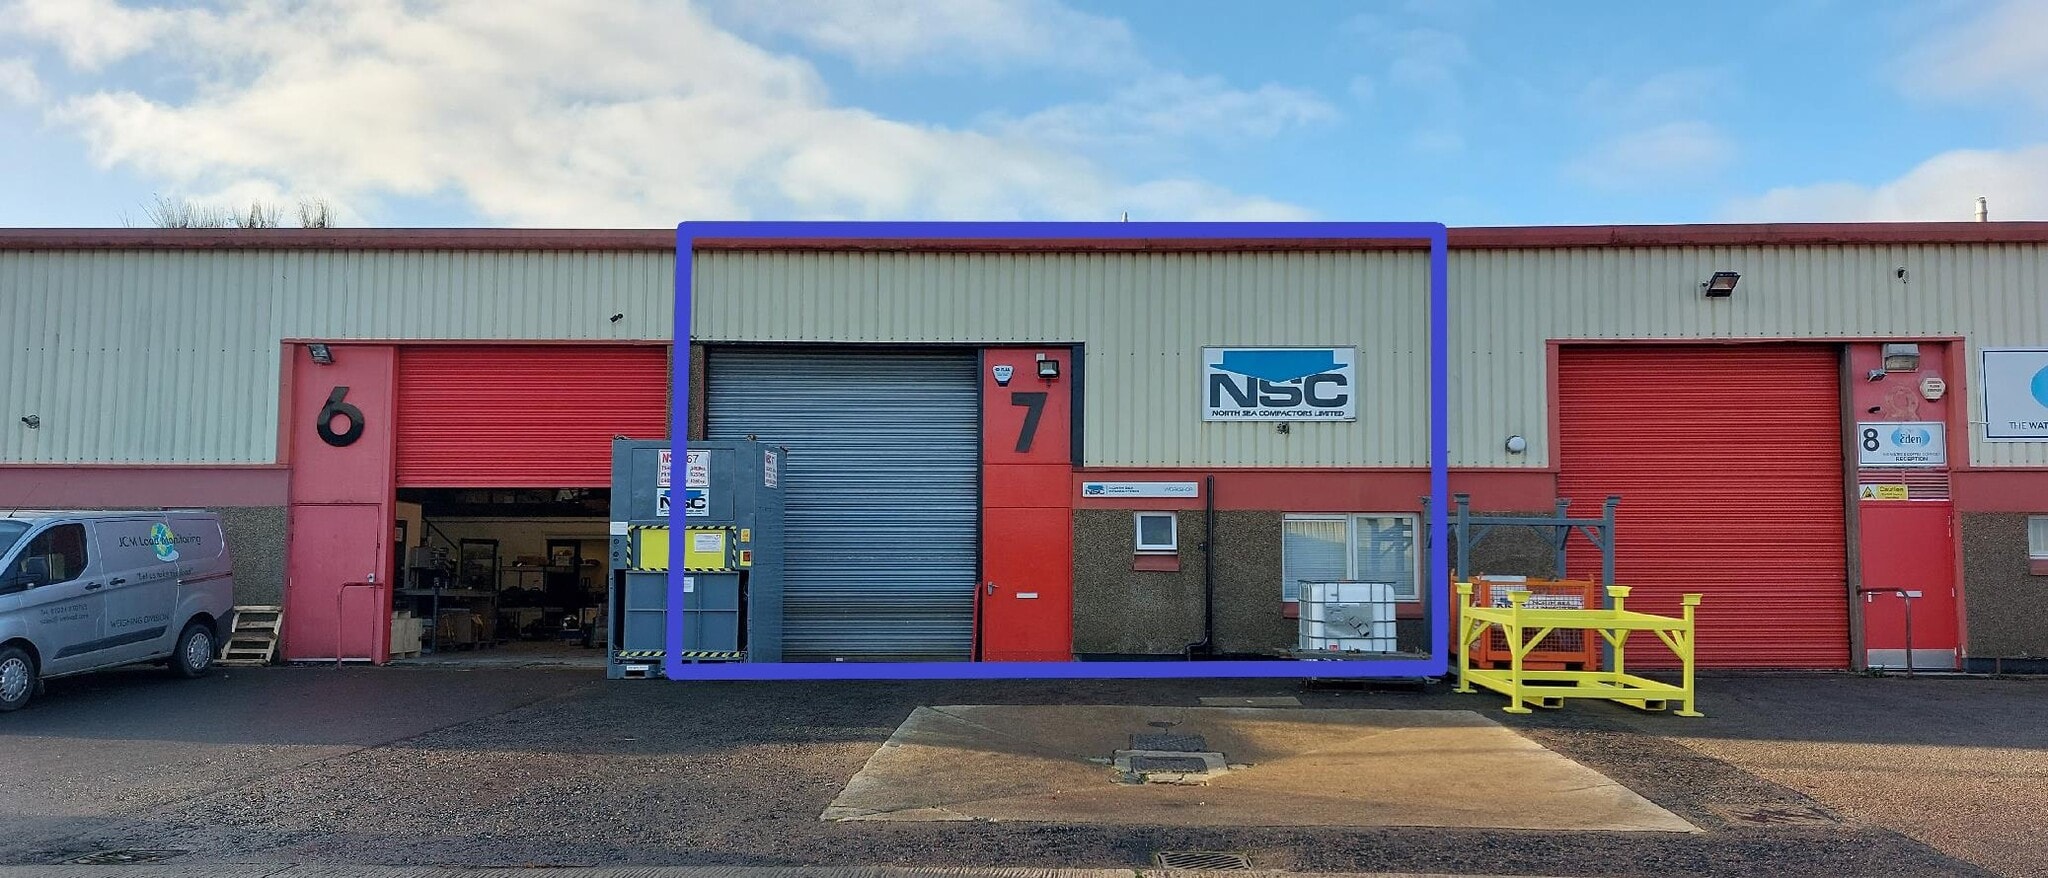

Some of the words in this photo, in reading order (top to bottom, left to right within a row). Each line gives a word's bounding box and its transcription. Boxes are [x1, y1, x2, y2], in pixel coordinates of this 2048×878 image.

[1209, 373, 1348, 408] NSC
[316, 386, 365, 447] 6
[1011, 392, 1048, 453] 7
[2008, 421, 2027, 430] THE
[1863, 428, 1880, 451] 8
[1899, 433, 1922, 444] Eden
[119, 535, 138, 547] JCM
[139, 535, 161, 547] Load
[162, 533, 201, 546] Monitoring
[110, 616, 143, 628] WEIGHING
[143, 613, 170, 624] DIVISION
